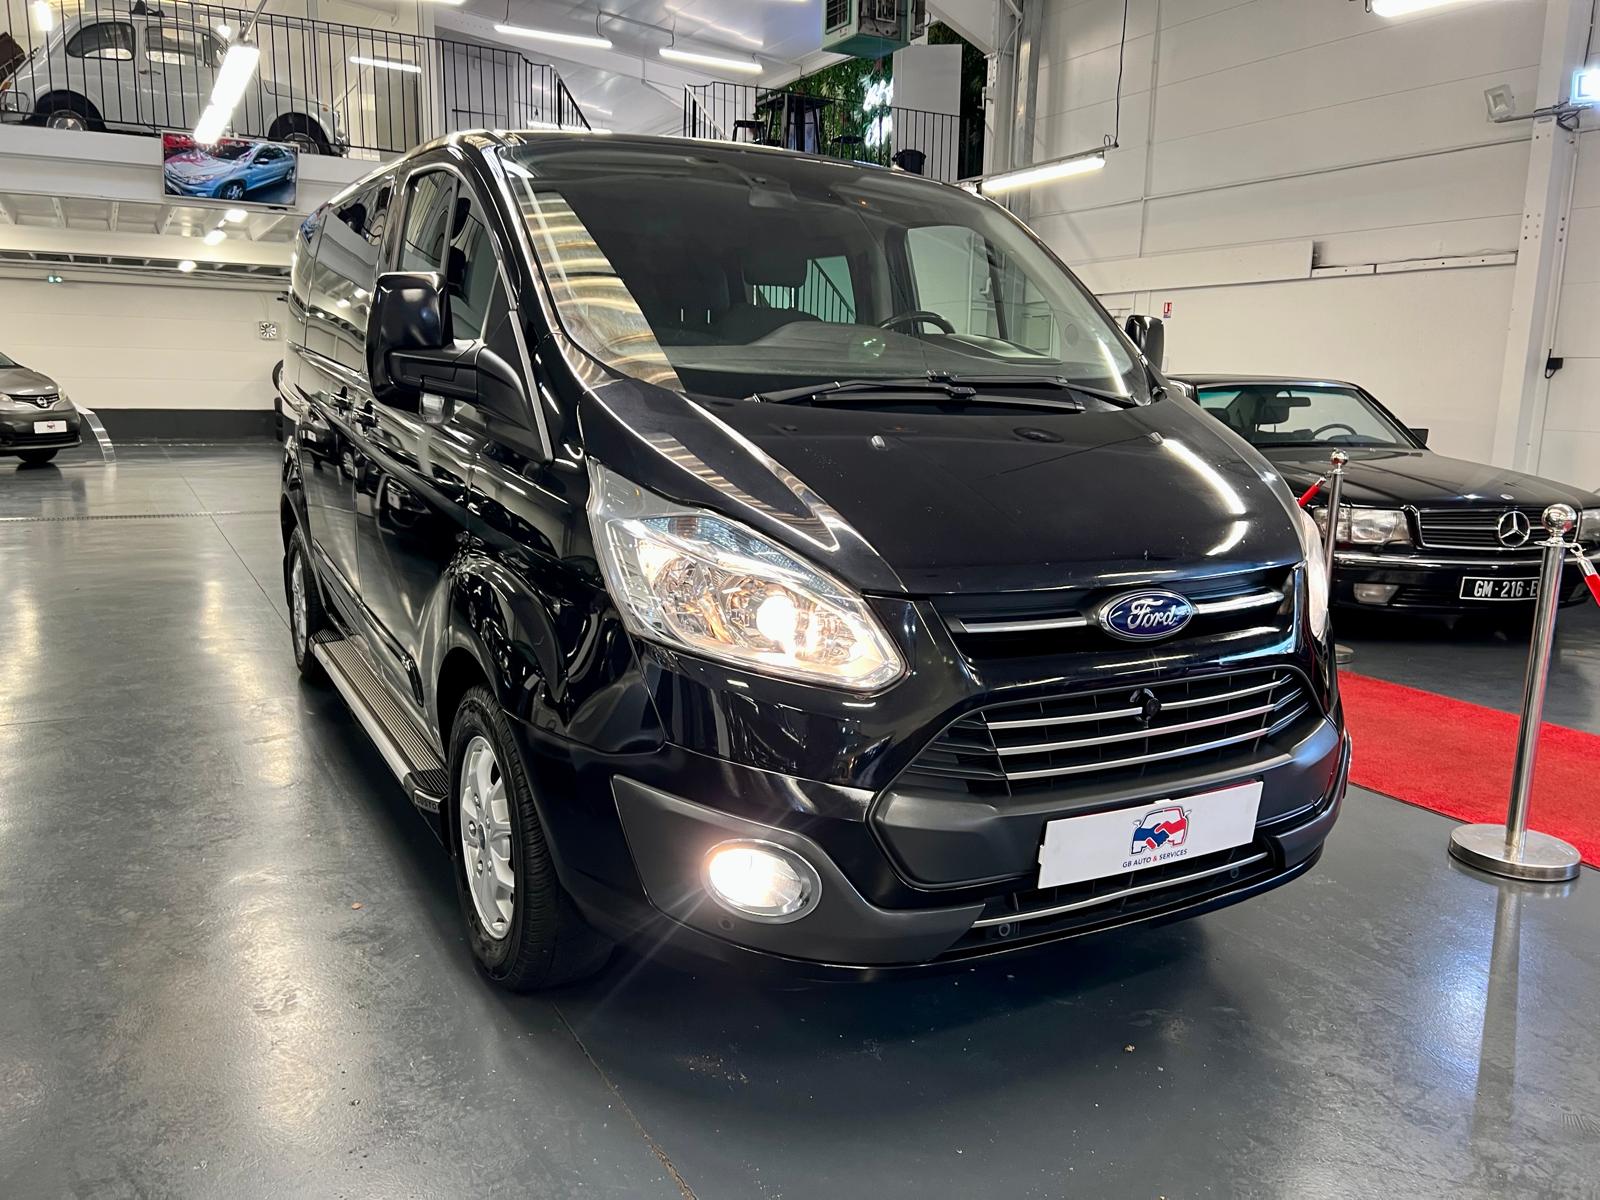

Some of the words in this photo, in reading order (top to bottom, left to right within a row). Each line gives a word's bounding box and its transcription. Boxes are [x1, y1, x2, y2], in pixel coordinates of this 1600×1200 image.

[1474, 580, 1539, 598] GM-216-E
[1127, 598, 1178, 629] Ford
[1122, 860, 1132, 868] GB
[1133, 856, 1152, 866] AUTO
[1152, 855, 1158, 863] &
[1159, 848, 1188, 860] SERVICES
